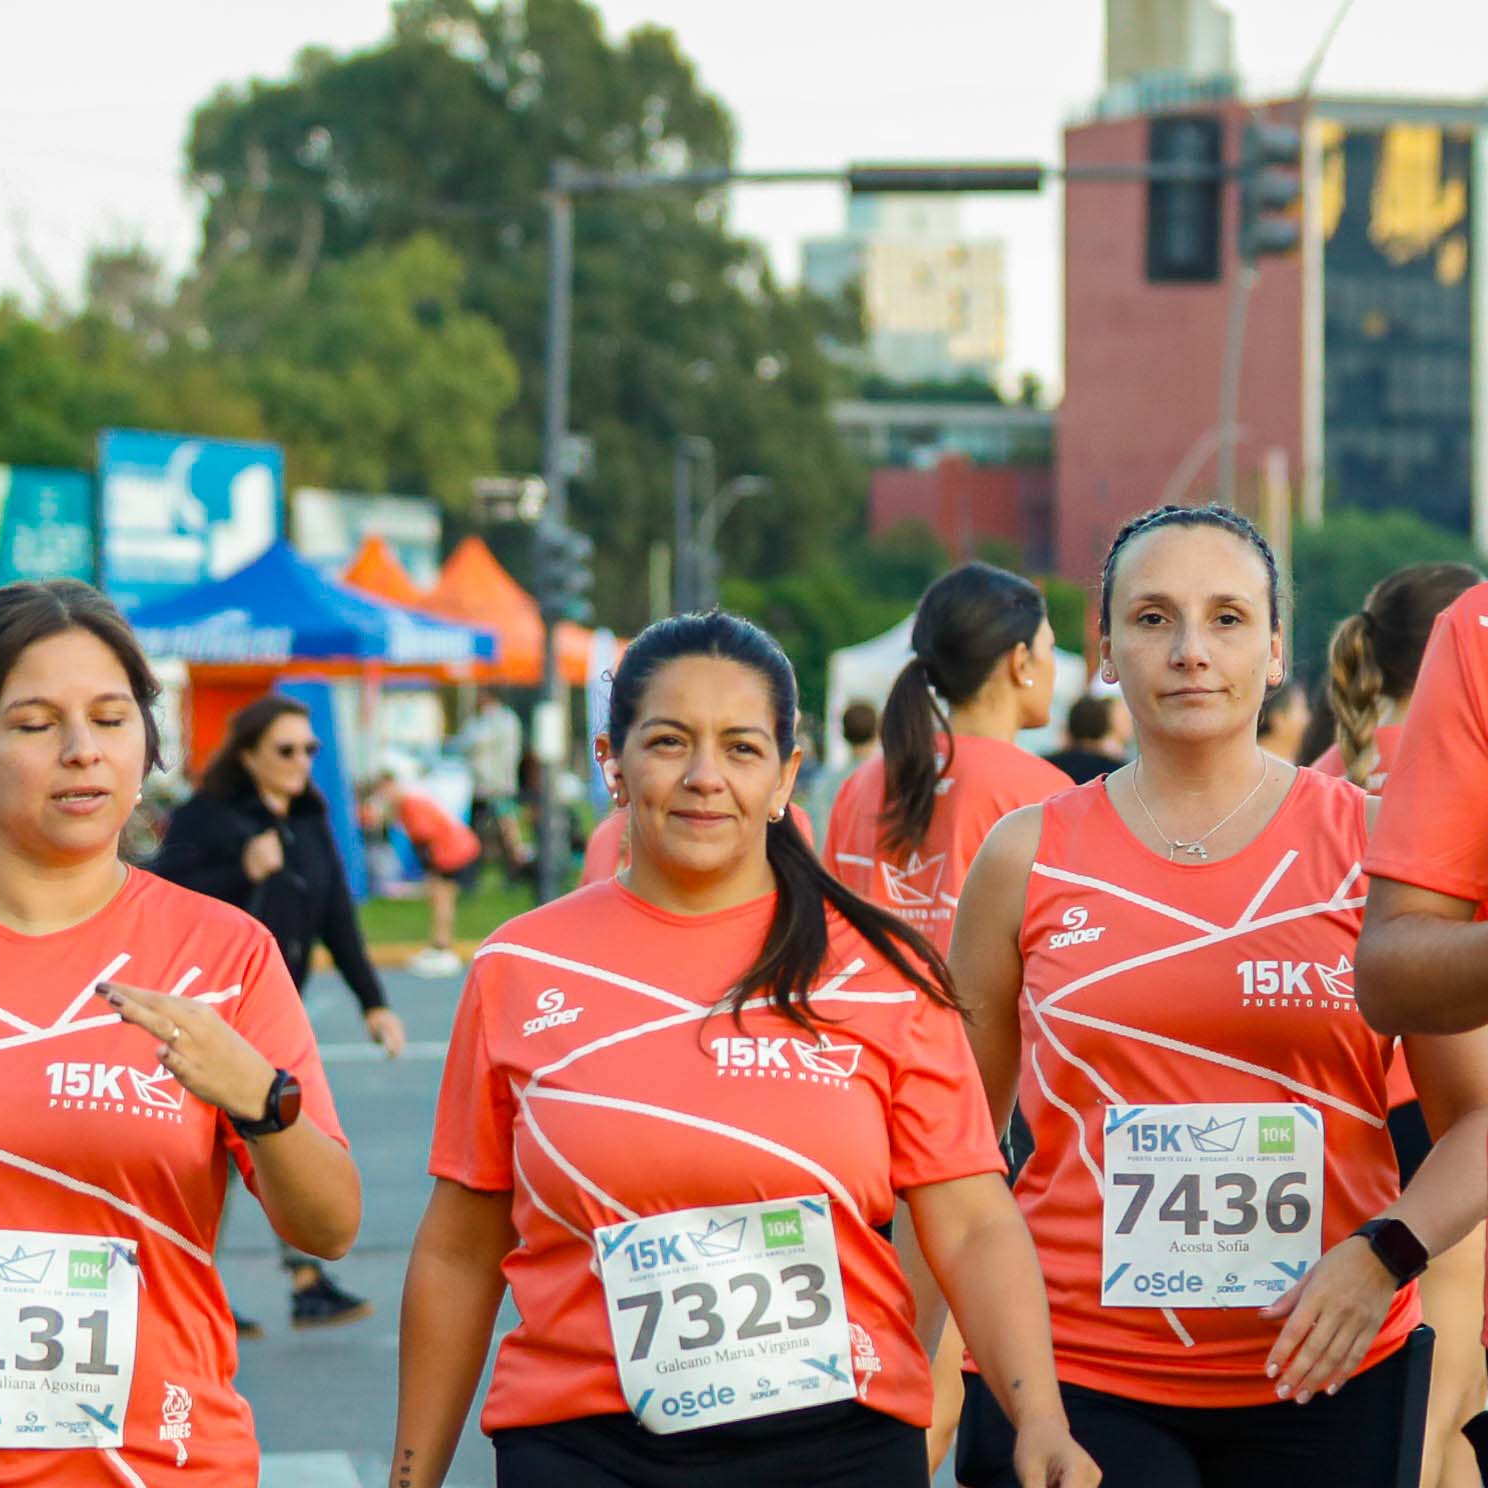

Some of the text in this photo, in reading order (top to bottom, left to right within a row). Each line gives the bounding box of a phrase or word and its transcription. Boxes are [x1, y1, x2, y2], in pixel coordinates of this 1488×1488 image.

[1236, 960, 1313, 995] 15K
[1242, 998, 1359, 1012] PUERTO NOR
[710, 1037, 791, 1069] 15K
[45, 1062, 128, 1100] 15K
[716, 1067, 851, 1090] PUERTO NORTE
[49, 1098, 184, 1124] PUERTO NORTE
[1127, 1124, 1182, 1152] 15K
[1261, 1127, 1291, 1142] 10K
[1112, 1171, 1311, 1236] 7436
[766, 1218, 798, 1236] 10K
[624, 1233, 687, 1273] 15K
[1168, 1240, 1213, 1253] Acosta
[72, 1260, 104, 1279] 10K
[1134, 1270, 1203, 1297] osde
[617, 1263, 832, 1363] 7323
[655, 1355, 712, 1376] Galeano
[757, 1336, 811, 1358] Virginia
[40, 1378, 100, 1395] Agostina
[662, 1384, 736, 1418] osde
